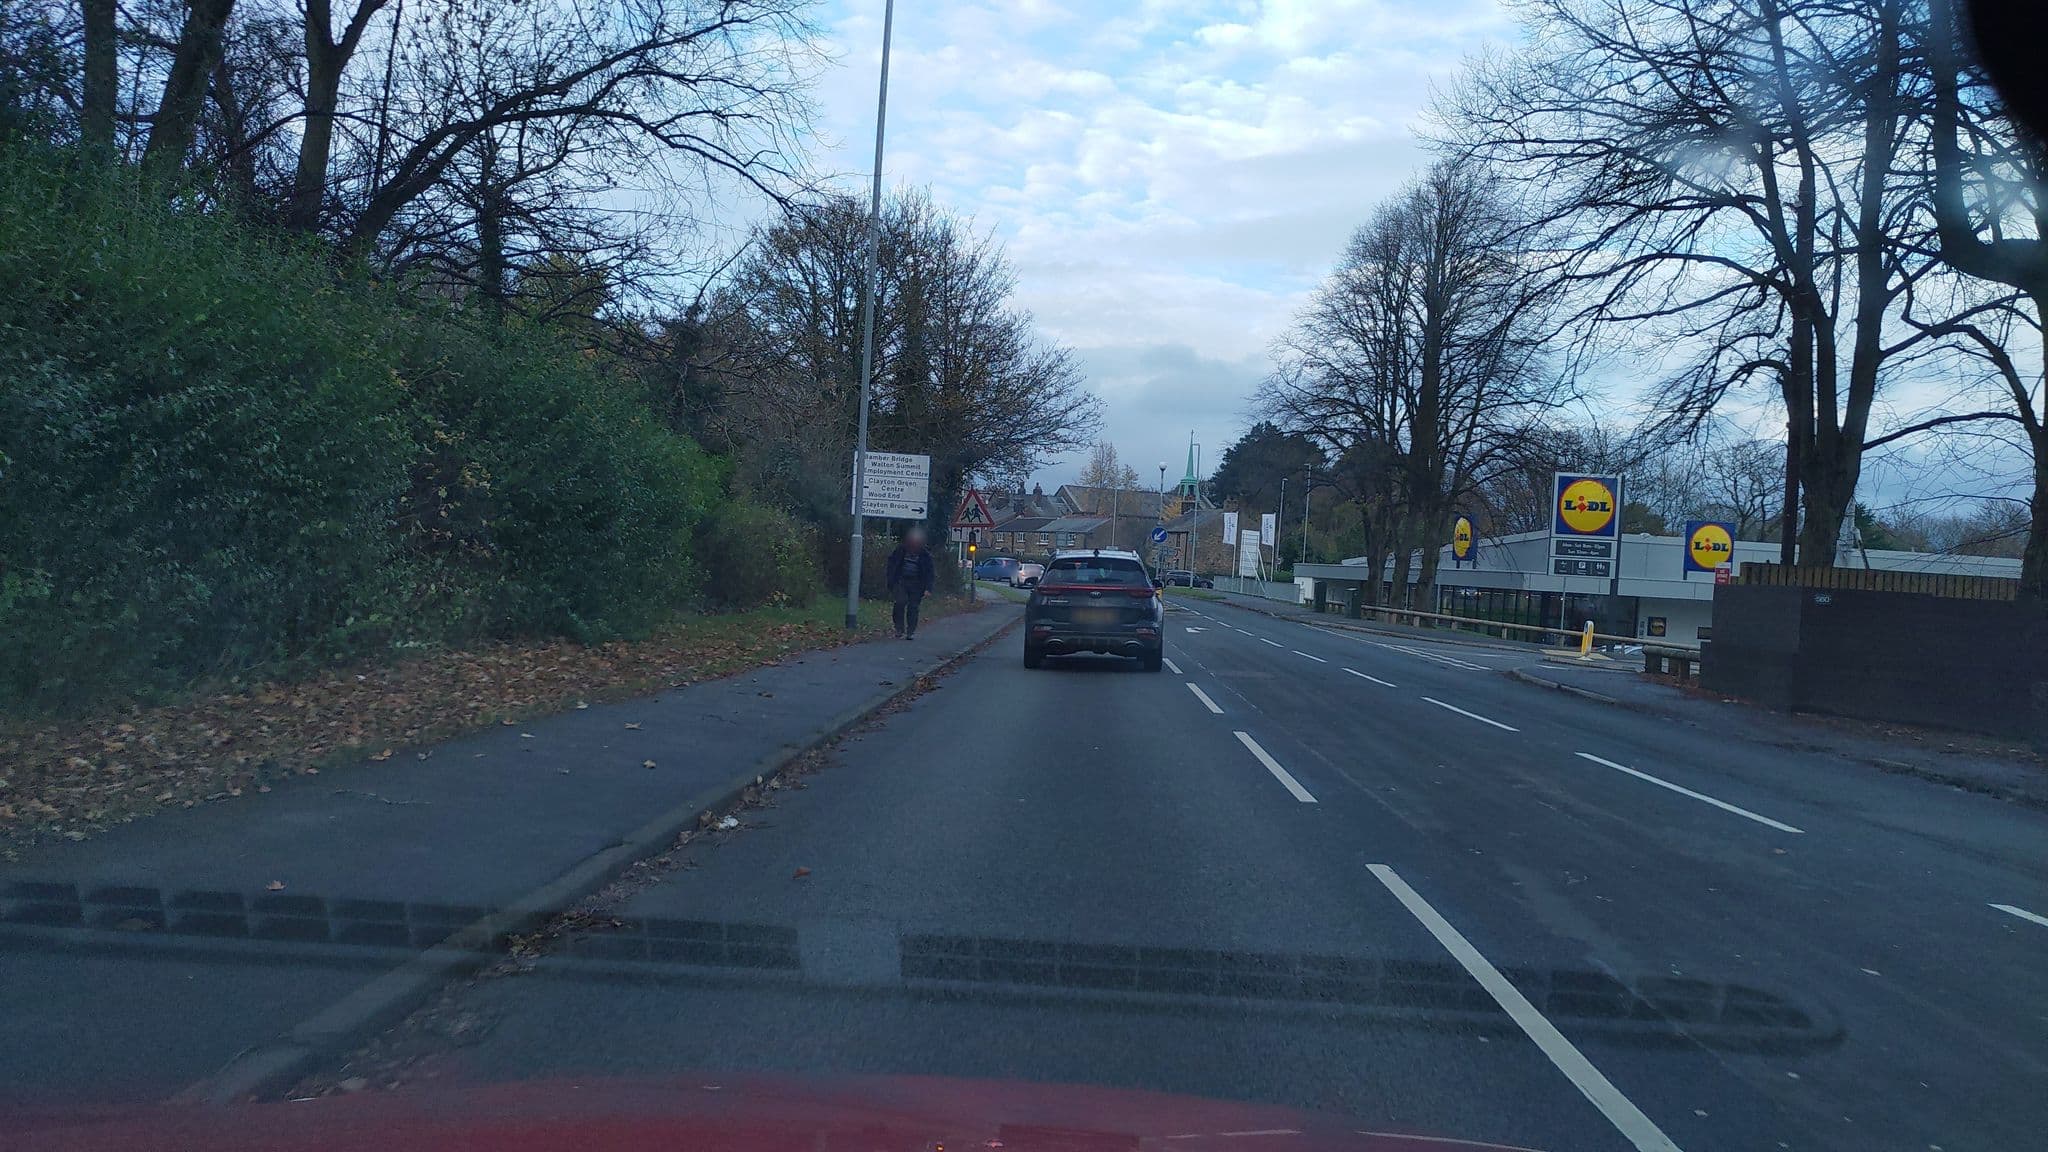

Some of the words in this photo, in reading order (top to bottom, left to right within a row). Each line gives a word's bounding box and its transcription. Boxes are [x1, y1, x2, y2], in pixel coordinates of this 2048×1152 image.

[891, 455, 913, 463] Bridge
[896, 462, 921, 470] Summit
[868, 477, 895, 485] Clayton
[897, 479, 917, 487] Green
